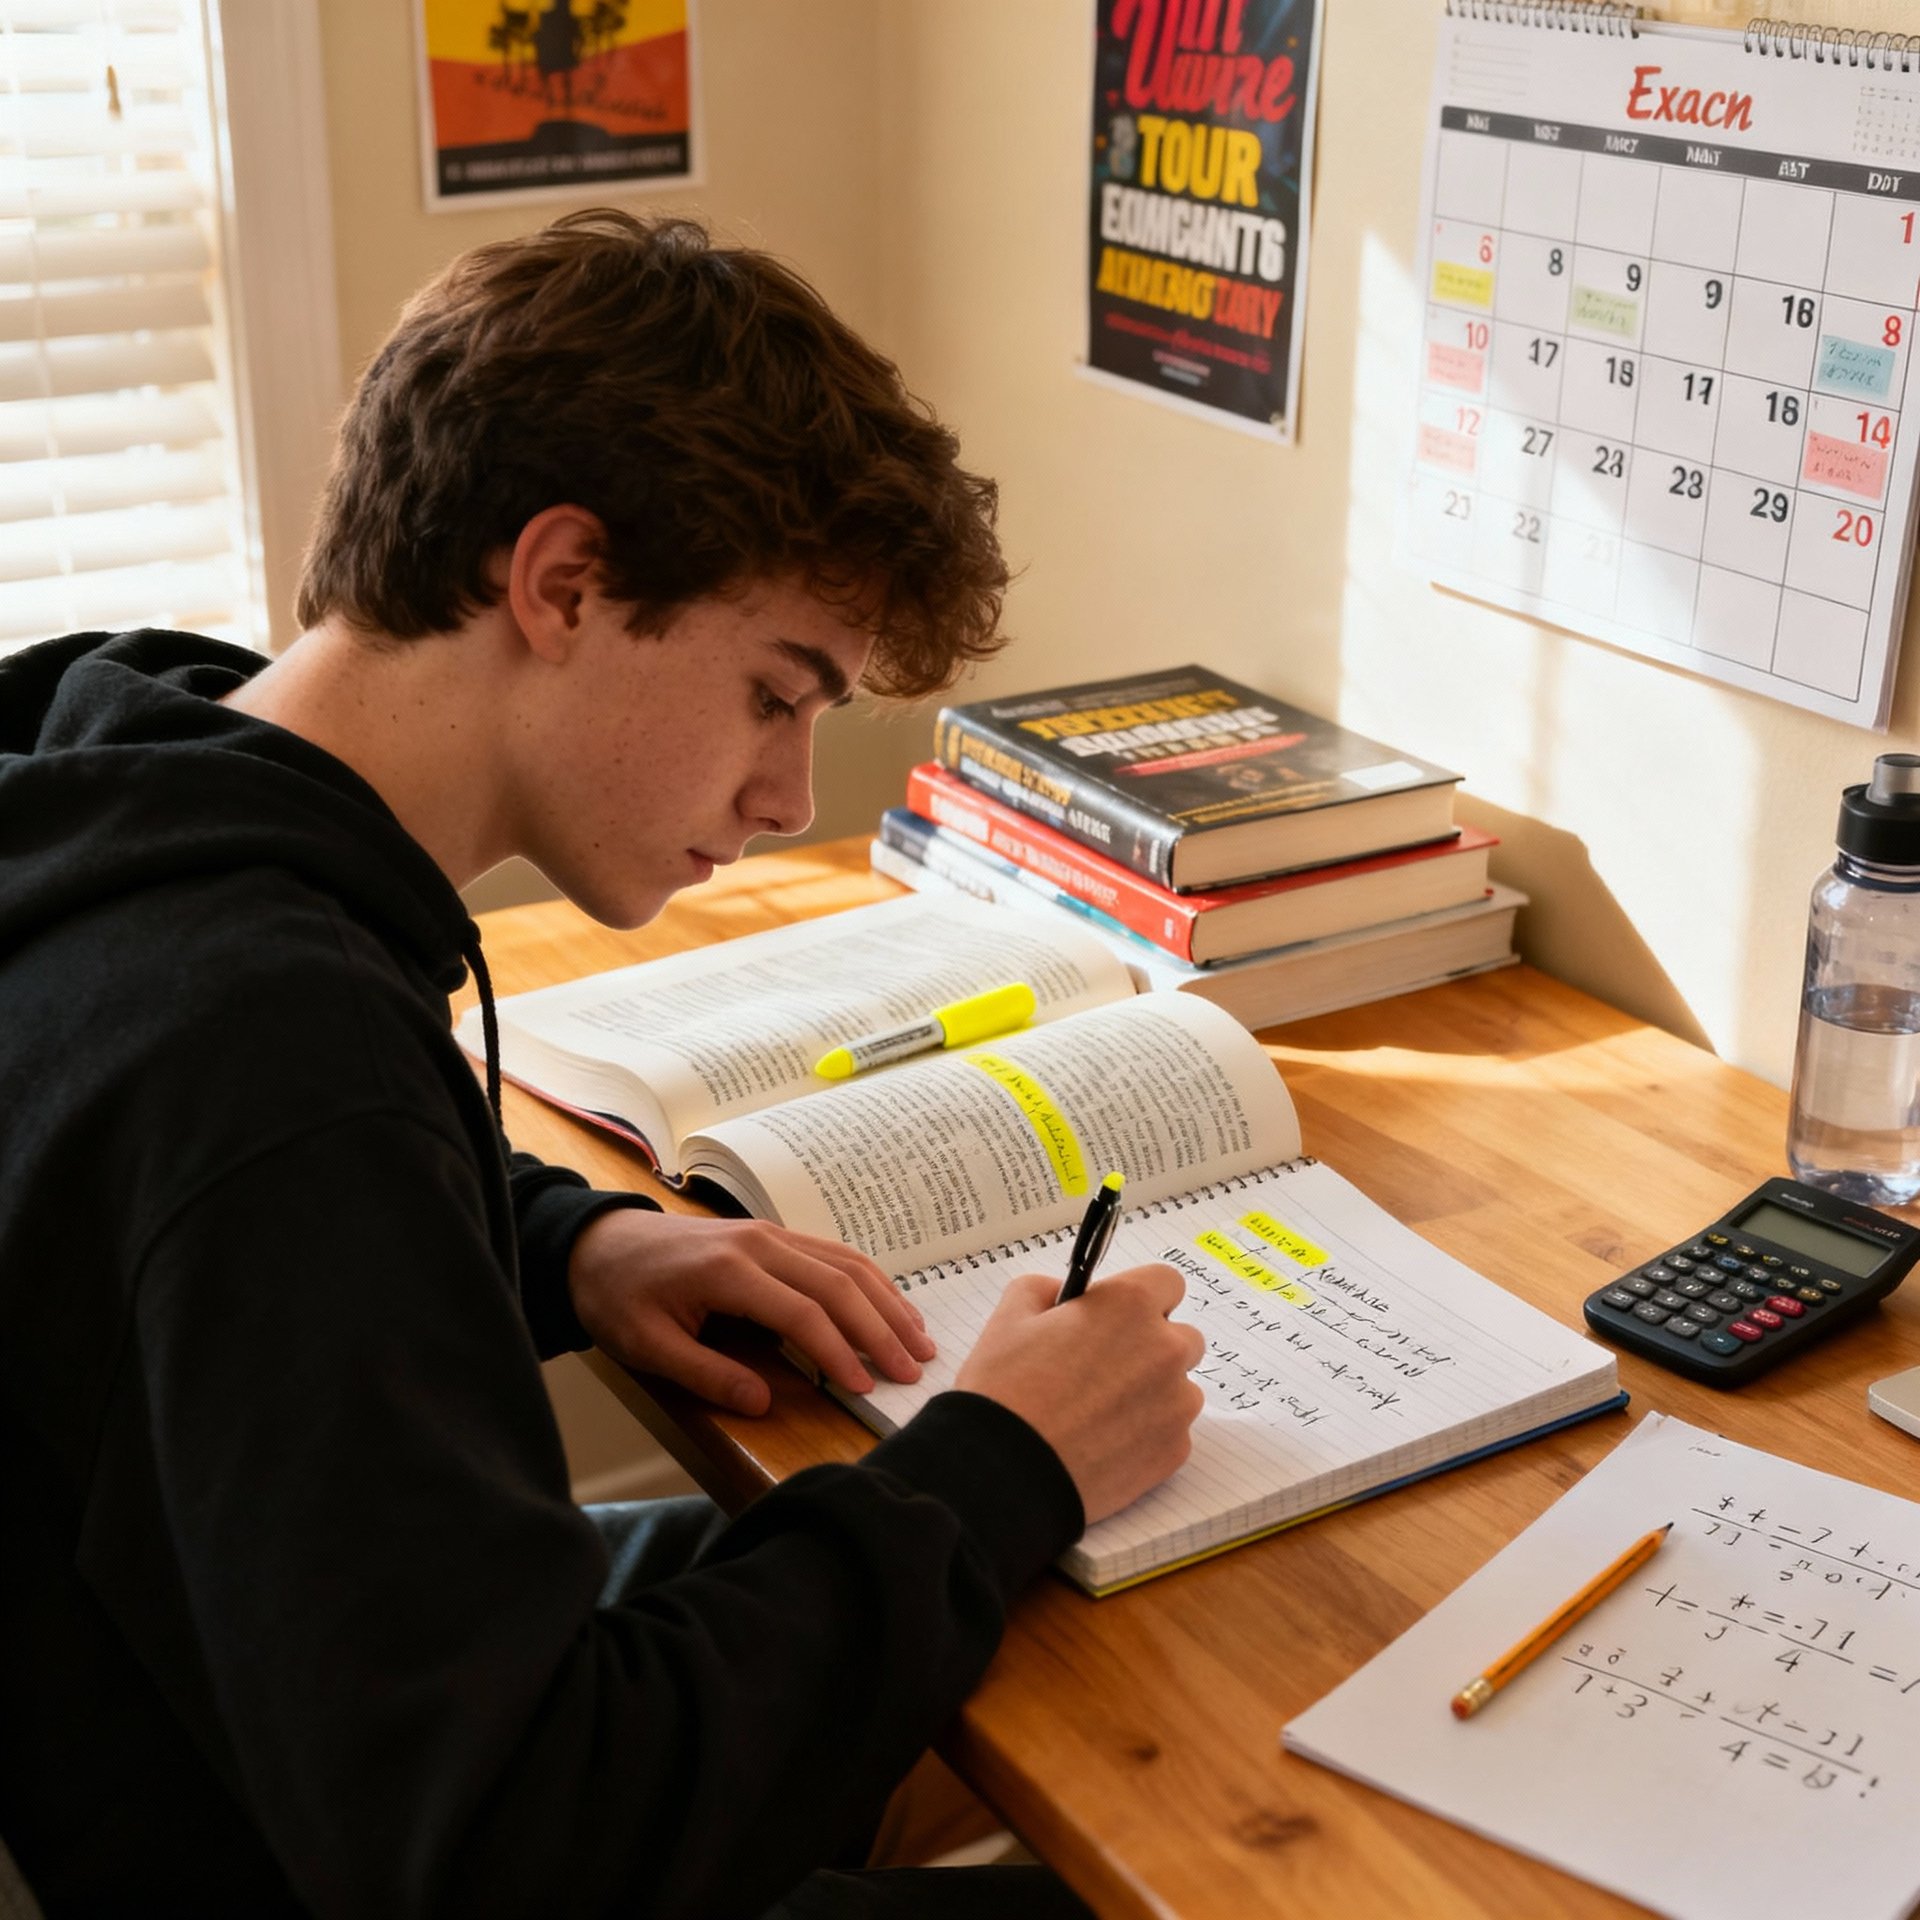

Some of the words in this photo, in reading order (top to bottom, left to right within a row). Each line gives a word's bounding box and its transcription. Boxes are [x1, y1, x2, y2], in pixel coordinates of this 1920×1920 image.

[1625, 64, 1754, 133] Exacn
[1137, 114, 1262, 208] TOUR
[1899, 210, 1917, 245] 1
[1547, 247, 1564, 277] 8
[1625, 262, 1643, 293] 9
[1704, 279, 1723, 310] 9
[1881, 314, 1903, 347] 8
[1465, 321, 1490, 351] 10
[1528, 337, 1560, 368] 17
[1456, 406, 1481, 437] 12
[1521, 426, 1555, 458] 27
[1831, 509, 1874, 548] 20
[1511, 512, 1543, 544] 22
